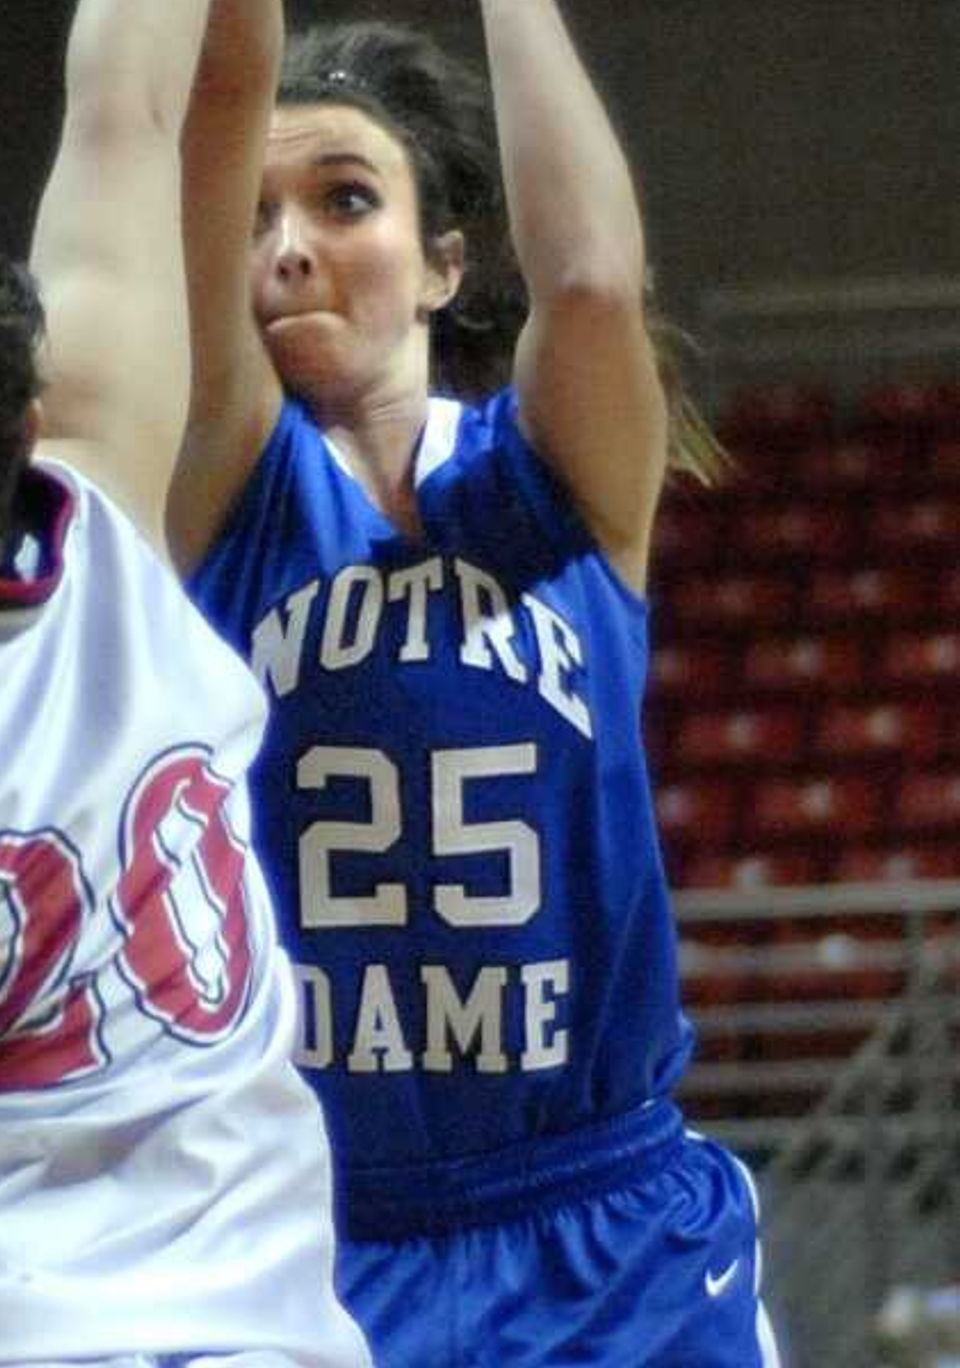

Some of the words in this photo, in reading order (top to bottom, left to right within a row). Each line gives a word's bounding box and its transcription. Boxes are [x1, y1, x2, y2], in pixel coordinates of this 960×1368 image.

[250, 557, 592, 739] NOTRE
[296, 743, 541, 929] 25
[293, 959, 570, 1073] DAME
